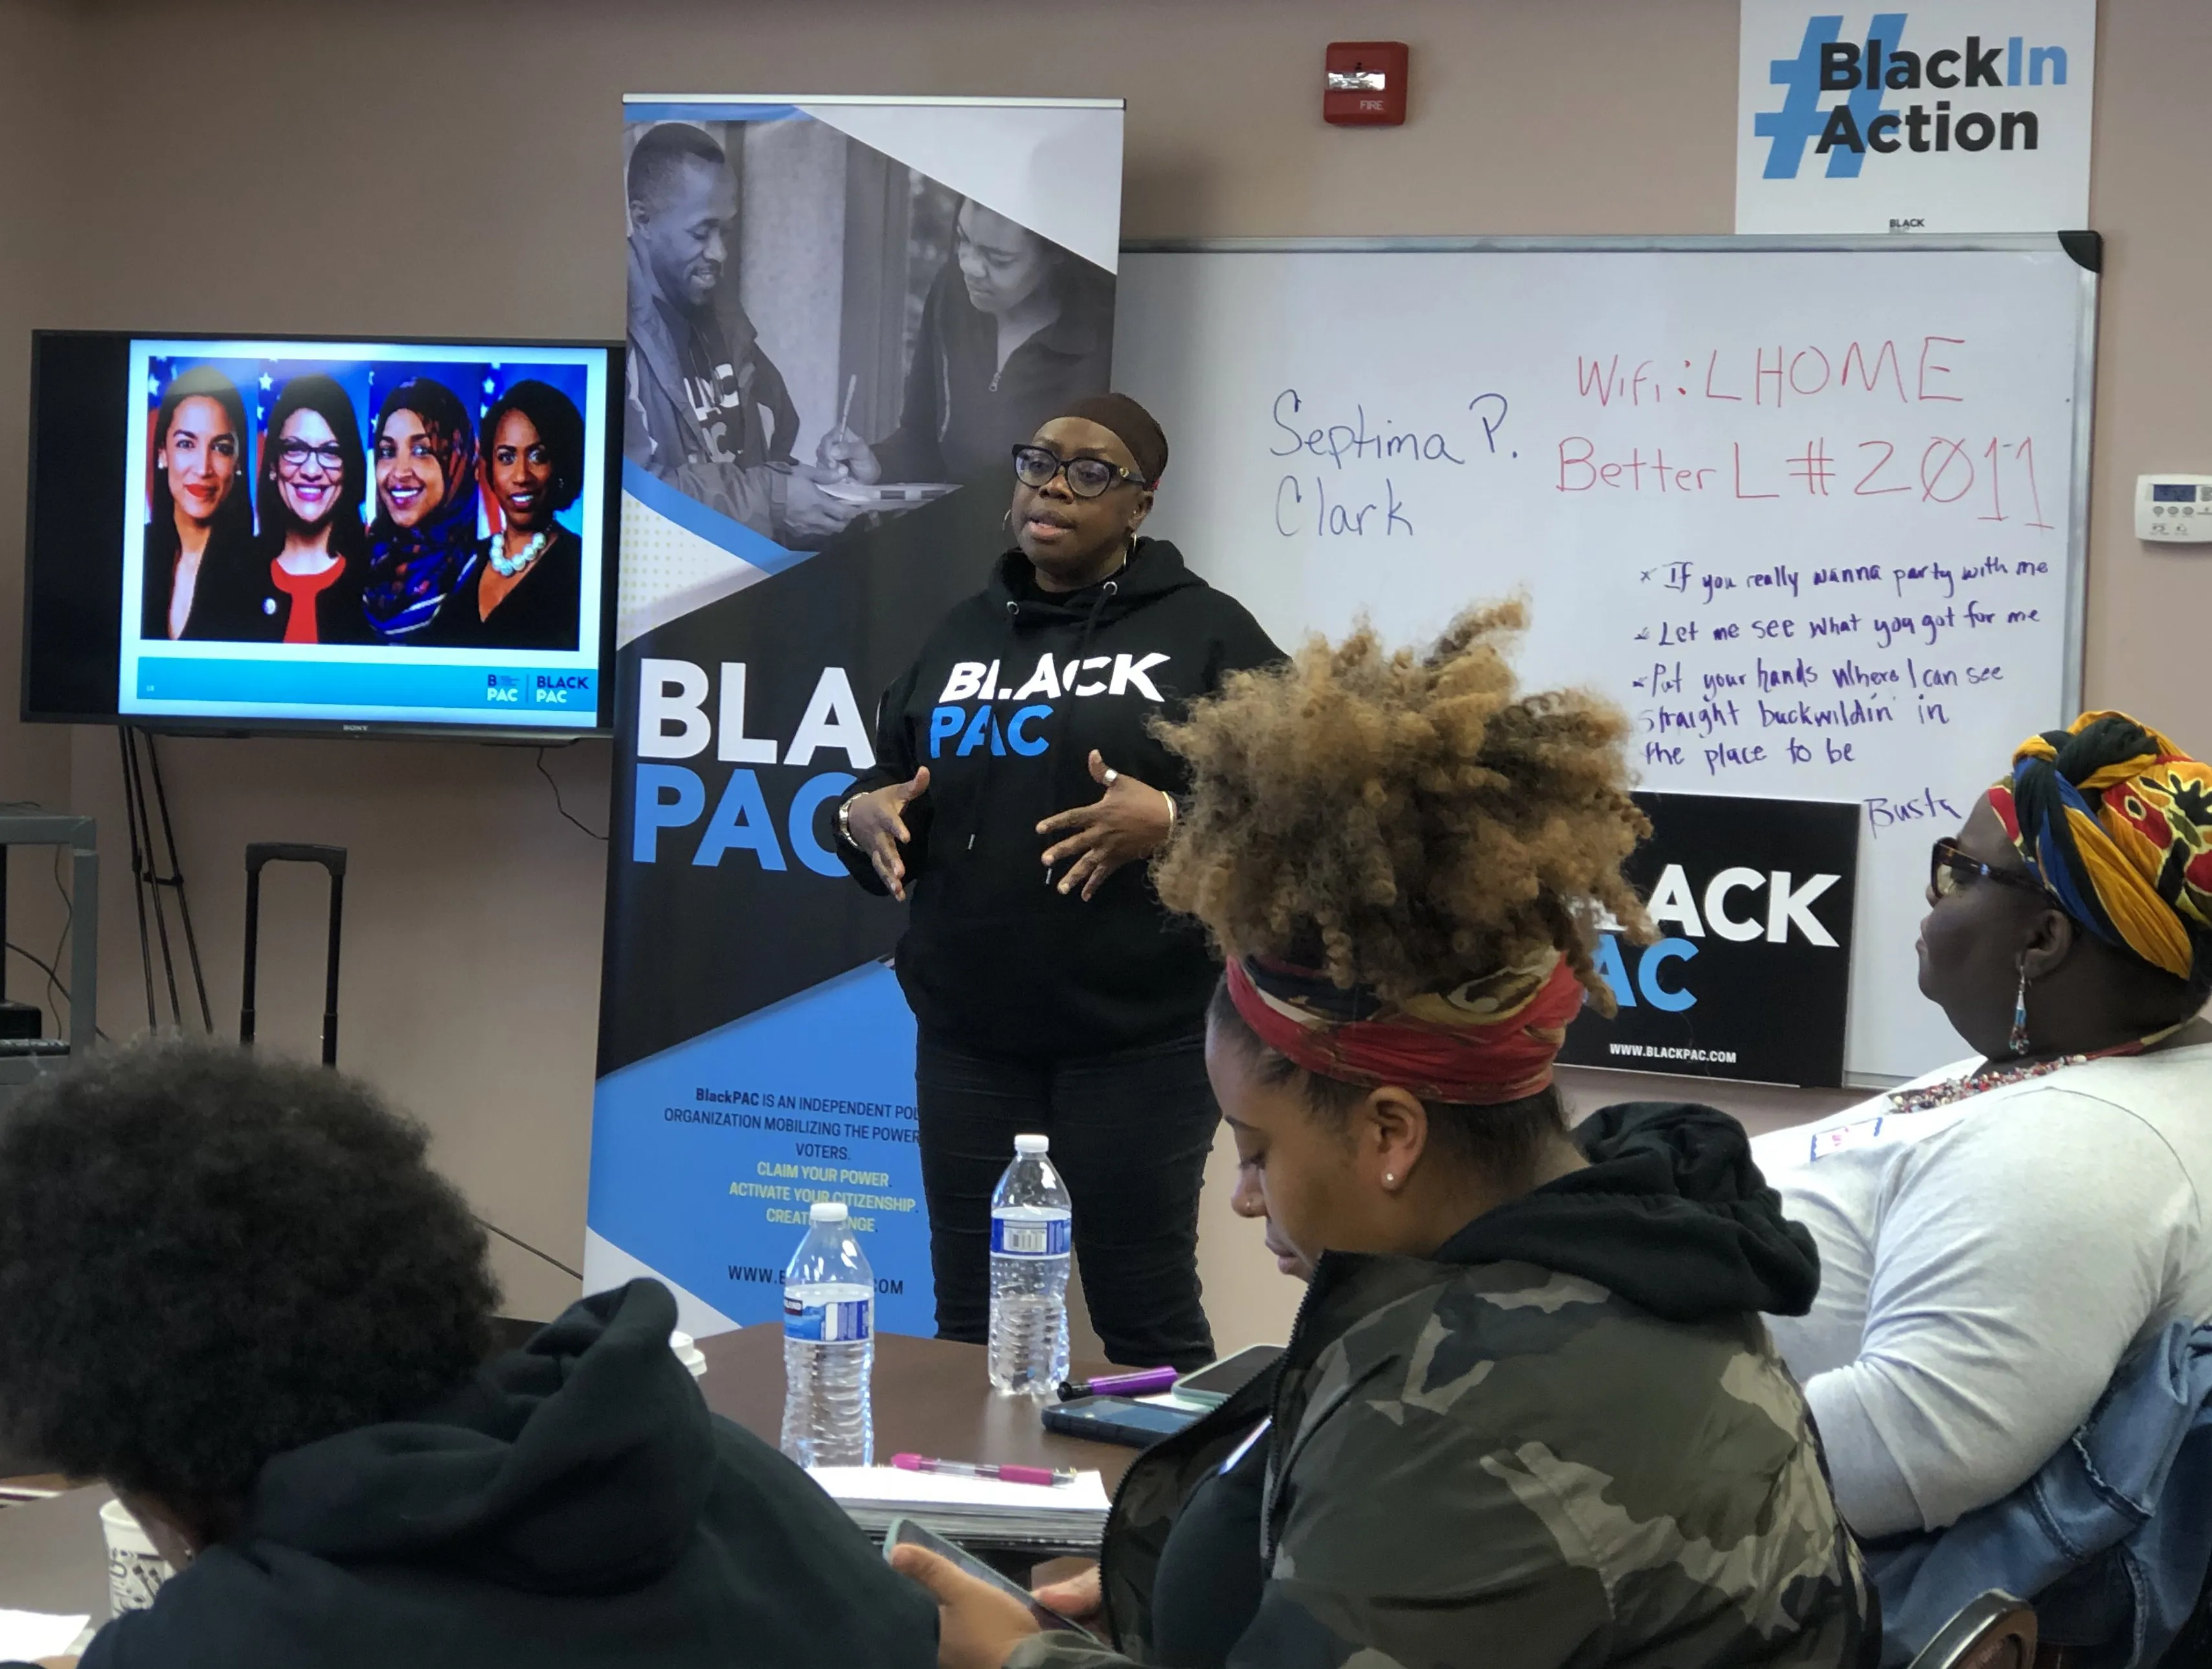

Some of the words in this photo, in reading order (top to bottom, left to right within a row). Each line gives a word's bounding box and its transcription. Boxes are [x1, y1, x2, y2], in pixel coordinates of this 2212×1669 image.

[1360, 100, 1384, 110] FIRE
[1815, 100, 2038, 154] Action
[1889, 218, 1925, 228] BLACK
[1706, 336, 1965, 407] LHOME
[1270, 389, 1465, 469] Septima
[1469, 393, 1517, 458] P.
[1276, 475, 1413, 536] Clark
[1662, 562, 1694, 593] If
[1702, 574, 1737, 604] you
[1746, 565, 1799, 597] really
[1893, 562, 1954, 598] party
[1961, 556, 2008, 580] with
[2016, 561, 2049, 575] me
[1658, 620, 1699, 646] Let
[1713, 623, 1740, 641] me
[1752, 619, 1795, 639] see
[1921, 606, 1956, 645] got
[1963, 600, 1996, 628] for
[2007, 609, 2040, 624] me
[487, 688, 518, 702] PAC
[536, 688, 568, 703] PAC
[537, 675, 589, 690] BLACK
[938, 652, 1171, 703] BLACK
[1702, 674, 1746, 702] your
[1757, 657, 1818, 693] hands
[1923, 669, 1958, 687] can
[1967, 666, 2004, 684] see
[637, 657, 878, 770] BLA
[1918, 694, 1950, 724] in
[930, 704, 1054, 759] PAC
[1644, 740, 1685, 765] the
[1703, 742, 1767, 776] place
[1786, 736, 1812, 765] to
[1826, 737, 1856, 764] be
[1582, 934, 1700, 1012] AC
[1609, 1043, 1737, 1064] WWW.BLACKPAC.COM
[664, 1107, 762, 1130] ORGANIZATION
[764, 1116, 841, 1137] MOBILIZING
[844, 1124, 870, 1139] THE
[695, 1087, 760, 1106] BlackPAC
[762, 1093, 775, 1107] IS
[777, 1095, 796, 1109] AN
[798, 1096, 892, 1118] INDEPENDENT
[895, 1105, 919, 1121] POL
[757, 1161, 798, 1179] CLAIM
[801, 1165, 837, 1182] YOUR
[729, 1181, 791, 1201] ACTIVATE
[793, 1188, 830, 1203] YOUR
